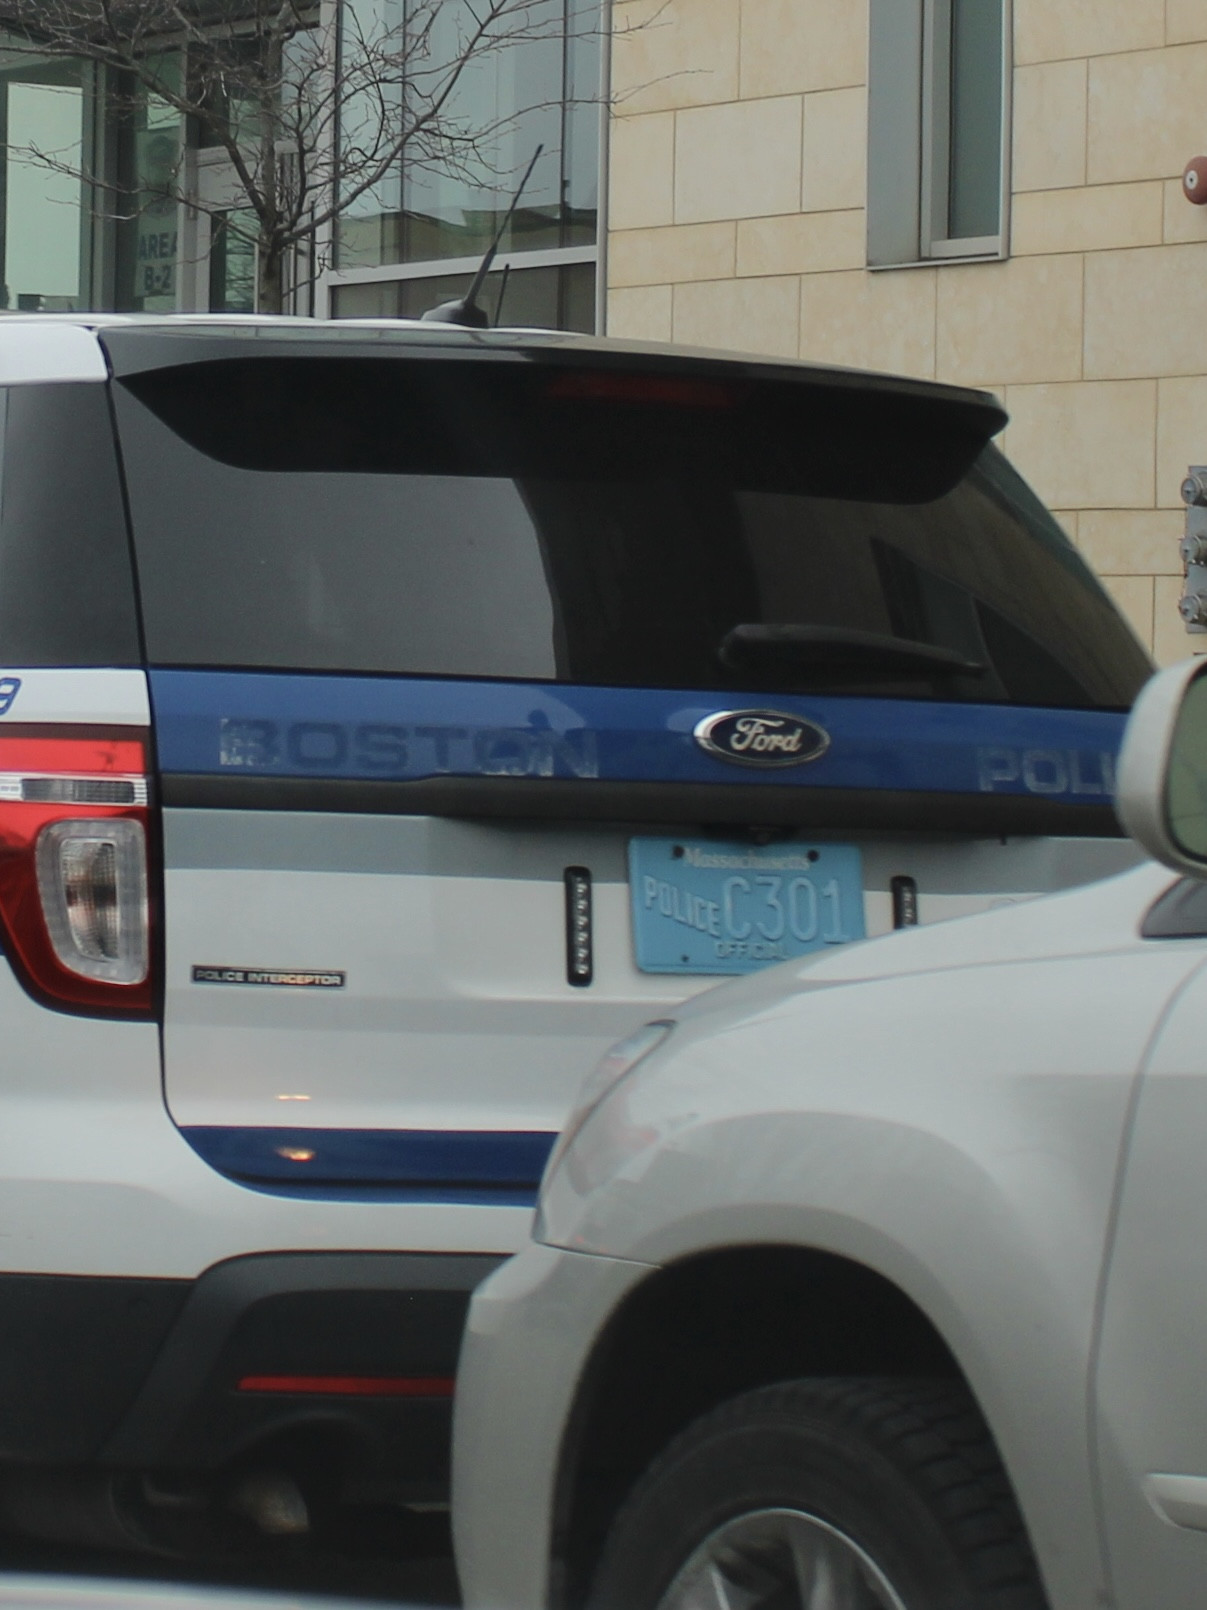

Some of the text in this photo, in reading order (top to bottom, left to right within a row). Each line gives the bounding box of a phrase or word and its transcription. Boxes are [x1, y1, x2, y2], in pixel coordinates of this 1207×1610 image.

[219, 717, 599, 778] BOSTON
[730, 717, 803, 752] Ford
[684, 848, 810, 870] Massachusetts
[643, 875, 851, 944] POLICE C301
[196, 969, 341, 985] POLICE INTERCEPTOR
